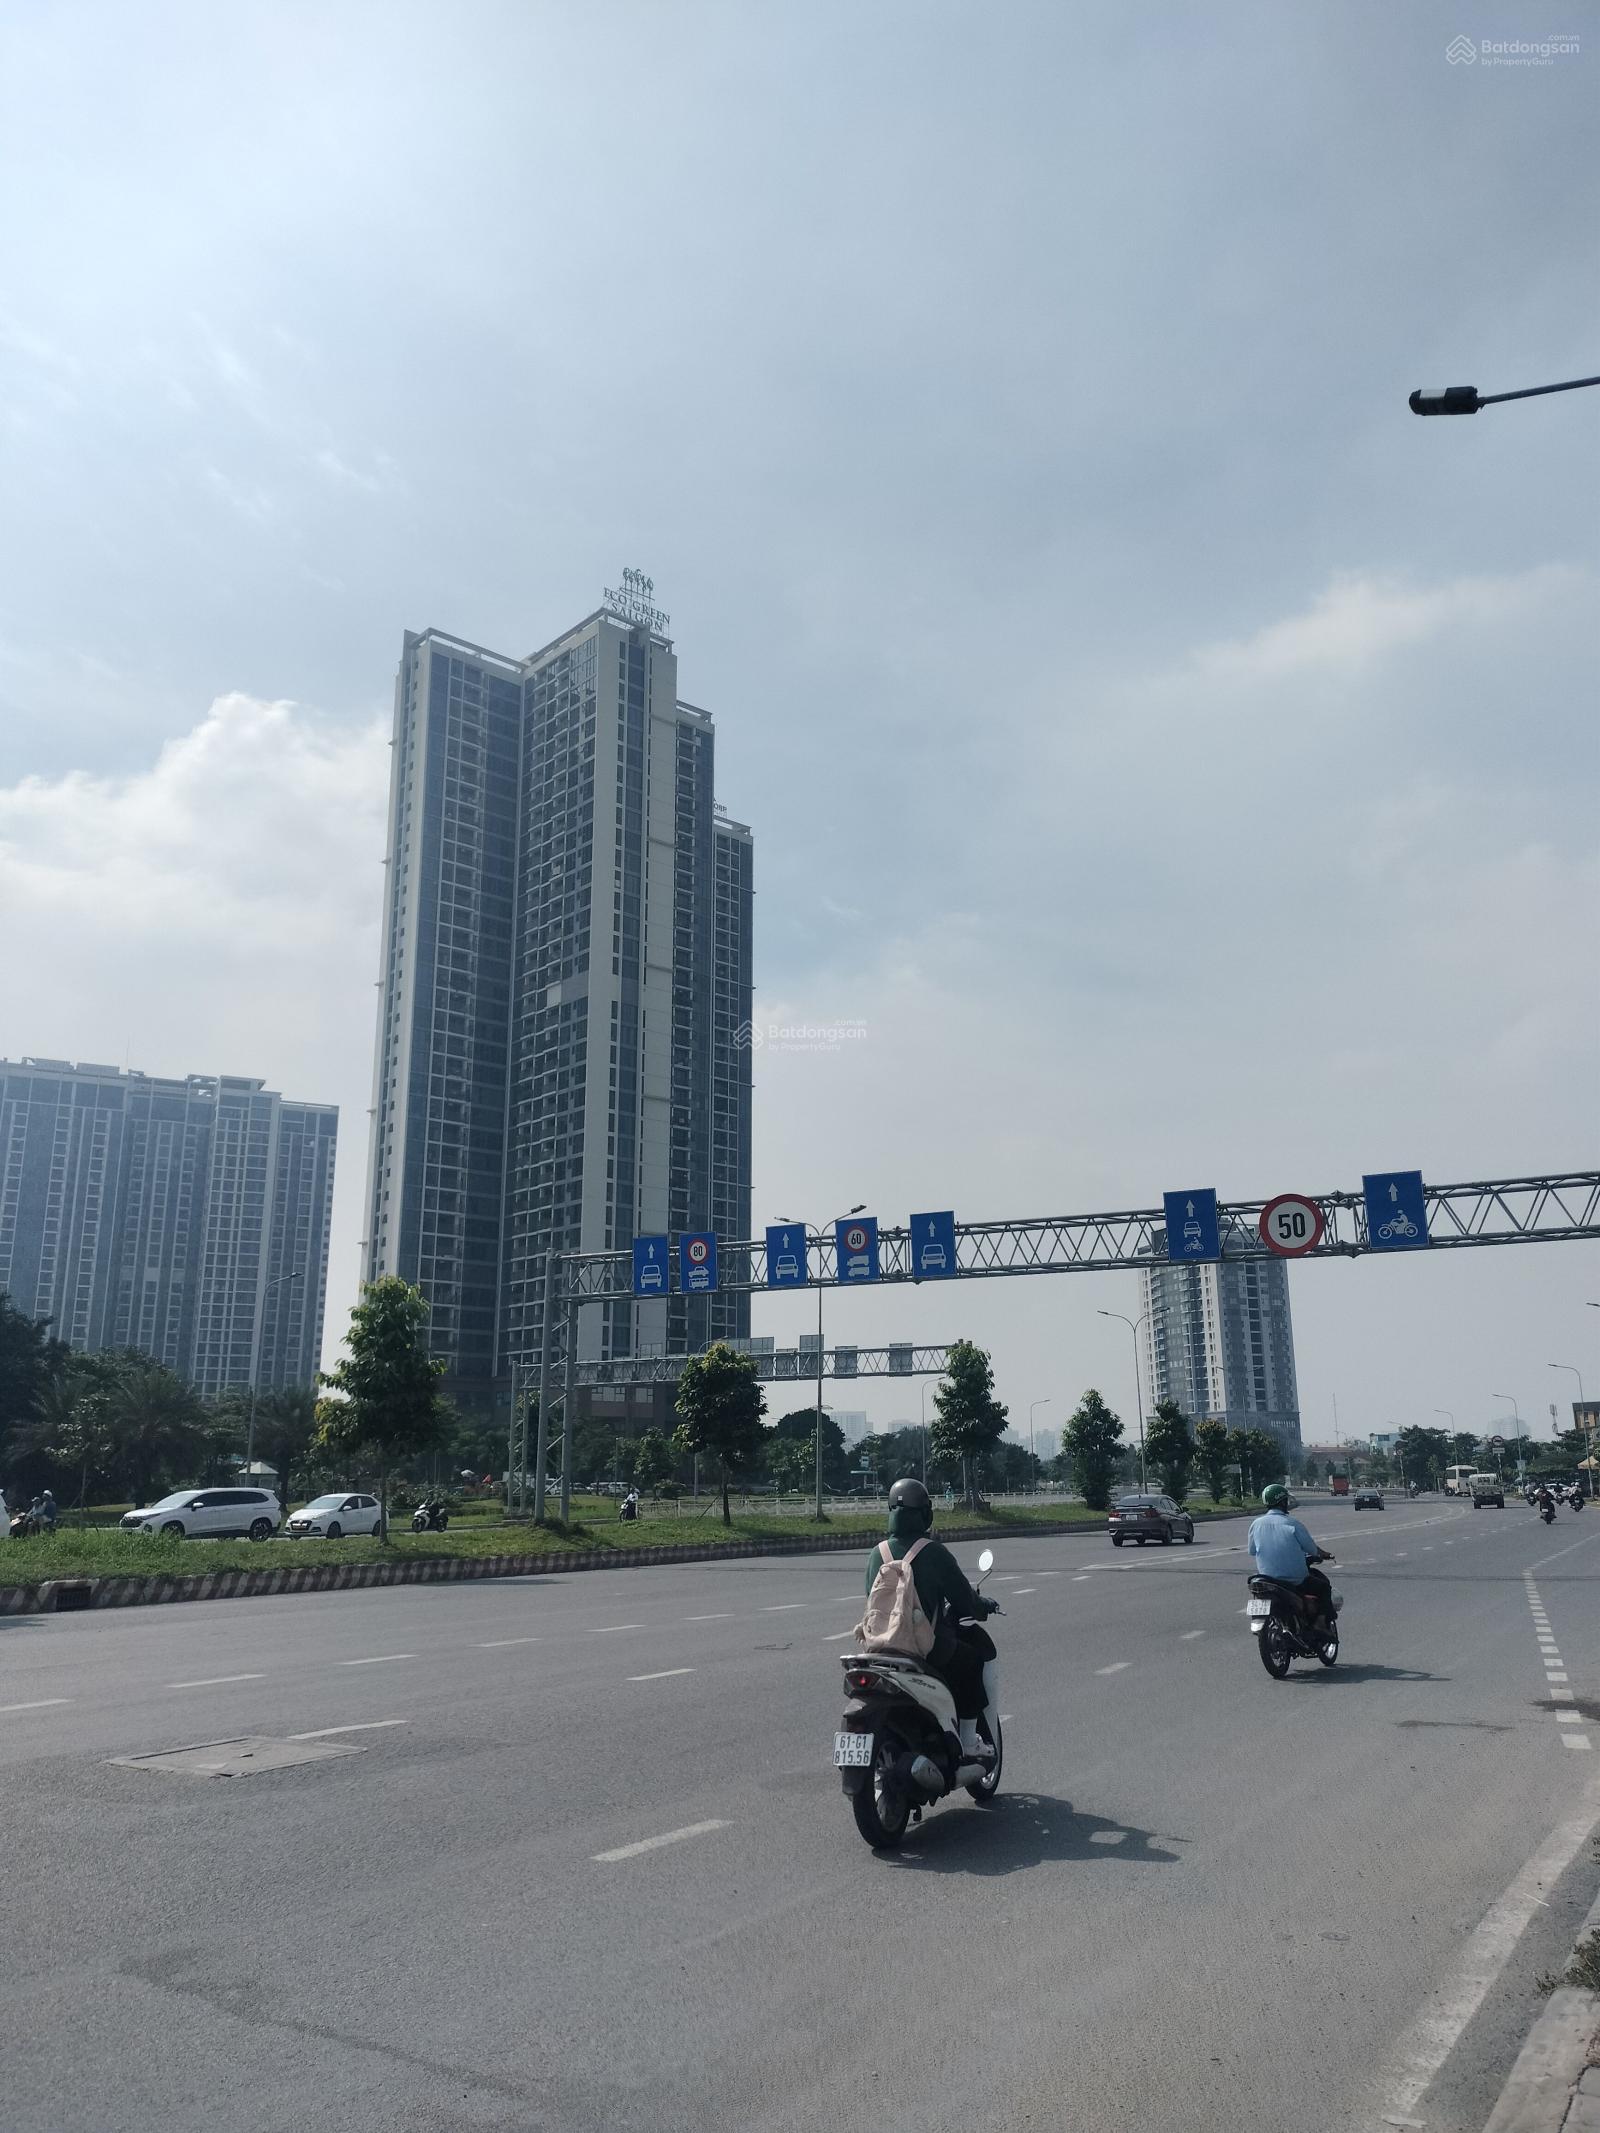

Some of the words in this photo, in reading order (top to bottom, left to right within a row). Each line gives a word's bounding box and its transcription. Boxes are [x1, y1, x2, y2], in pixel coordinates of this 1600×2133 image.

[604, 587, 627, 605] ECO
[633, 601, 670, 624] GREEN
[611, 603, 663, 632] SAIGON
[1278, 1212, 1306, 1240] 50
[851, 1233, 862, 1245] 60
[693, 1245, 703, 1257] 80
[840, 1735, 867, 1749] 61-G1
